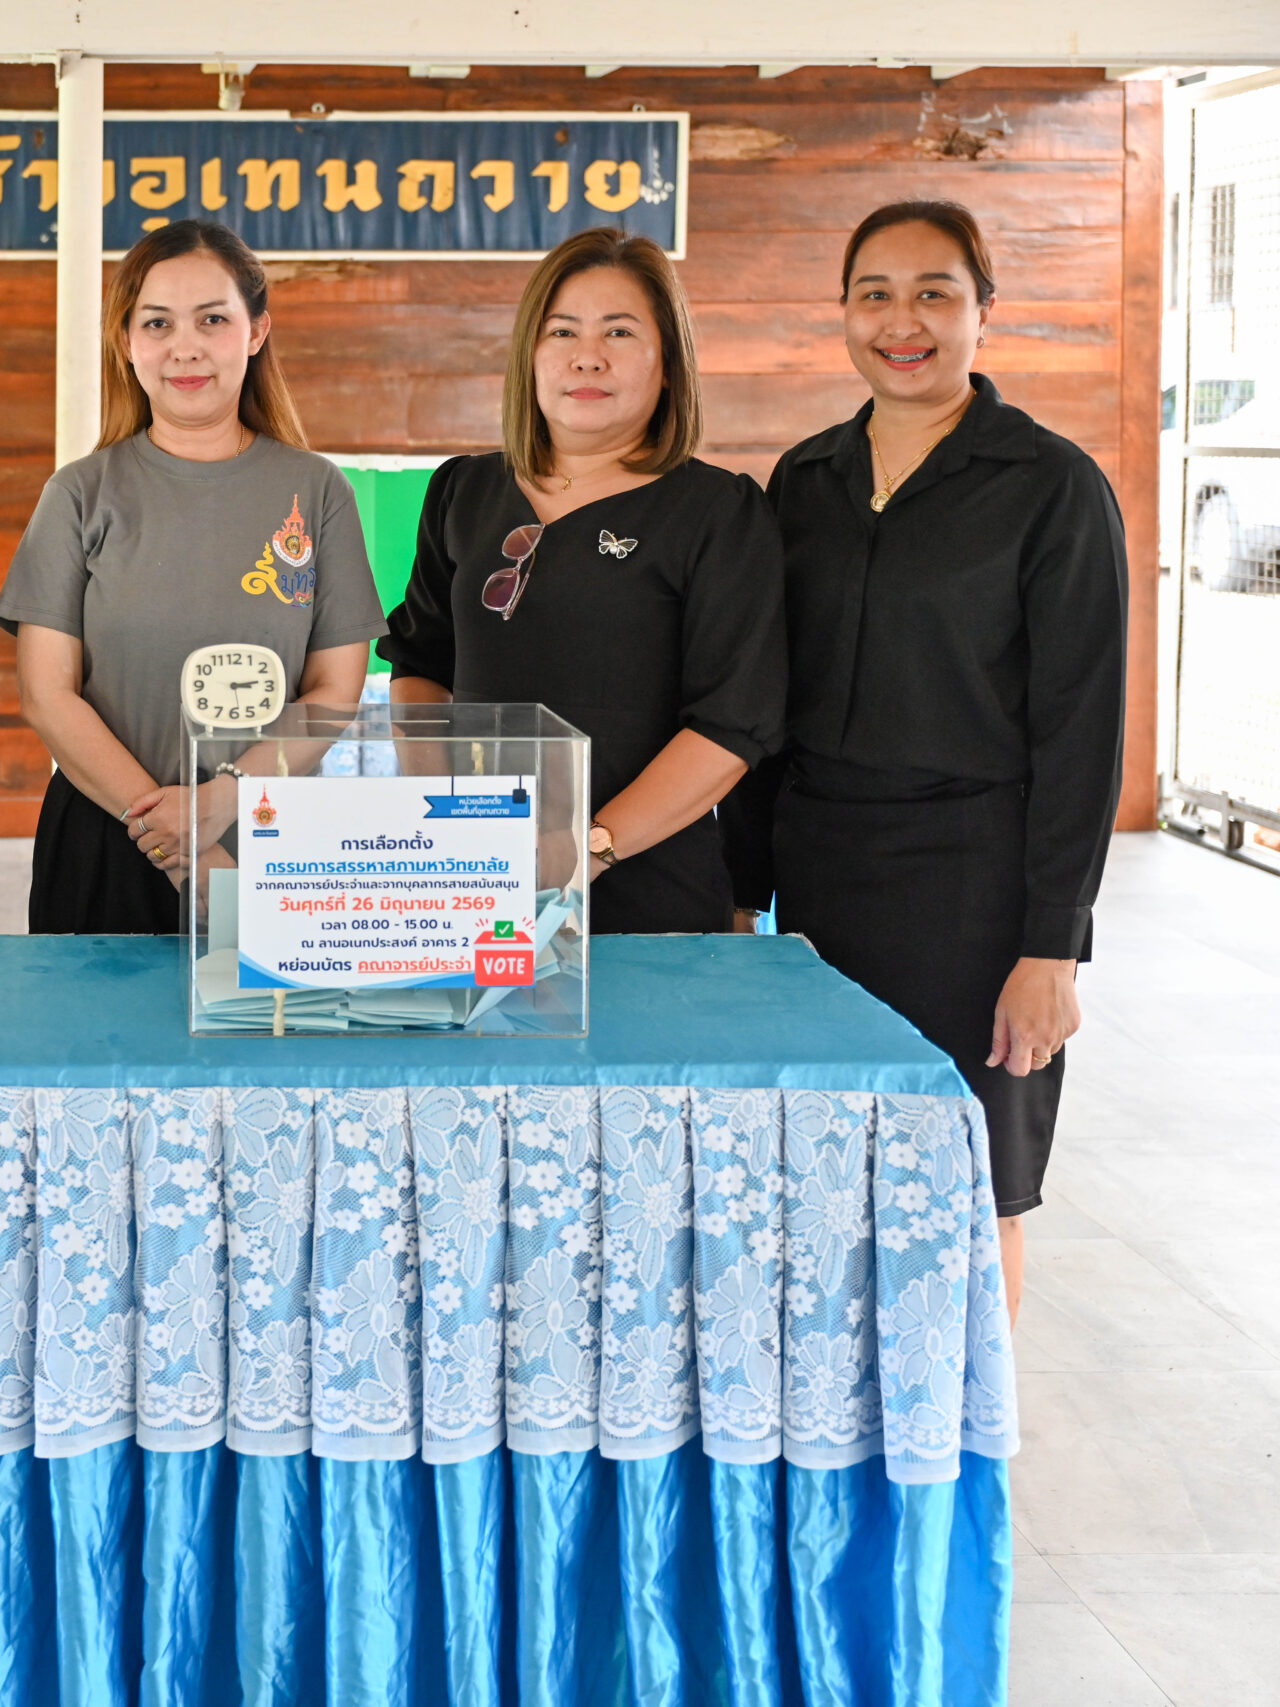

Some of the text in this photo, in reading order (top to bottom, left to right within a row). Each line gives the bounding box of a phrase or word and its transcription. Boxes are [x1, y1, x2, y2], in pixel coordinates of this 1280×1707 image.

[211, 654, 224, 666] 11
[226, 653, 242, 665] 12
[247, 654, 253, 666] 1
[195, 664, 212, 676] 10
[258, 662, 268, 674] 2
[193, 680, 205, 692] 9
[264, 680, 275, 692] 3
[197, 697, 209, 710] 8
[259, 697, 271, 709] 4
[214, 706, 224, 718] 7
[228, 706, 240, 719] 6
[245, 705, 256, 718] 5
[340, 831, 434, 850] การเลือกตั้ง
[265, 856, 509, 873] กรรมการสรรหาสภามหาวิทยาลัย
[255, 878, 519, 892] จากคณาจารย์ประจำและจากบุคลากรสายสนับสนุน
[279, 893, 495, 916] วันศุกร์ที่ 26 มิถุนายน 2569
[321, 920, 347, 930] เวลา
[351, 919, 390, 930] 08.00
[404, 919, 438, 929] 15.00
[443, 920, 454, 929] น.
[301, 935, 469, 949] ณ ลานอเนกประสงค์ อาคาร 2
[278, 956, 472, 973] หย่อนบัตร คณาจารย์ประจำ
[482, 956, 526, 975] VOTE
